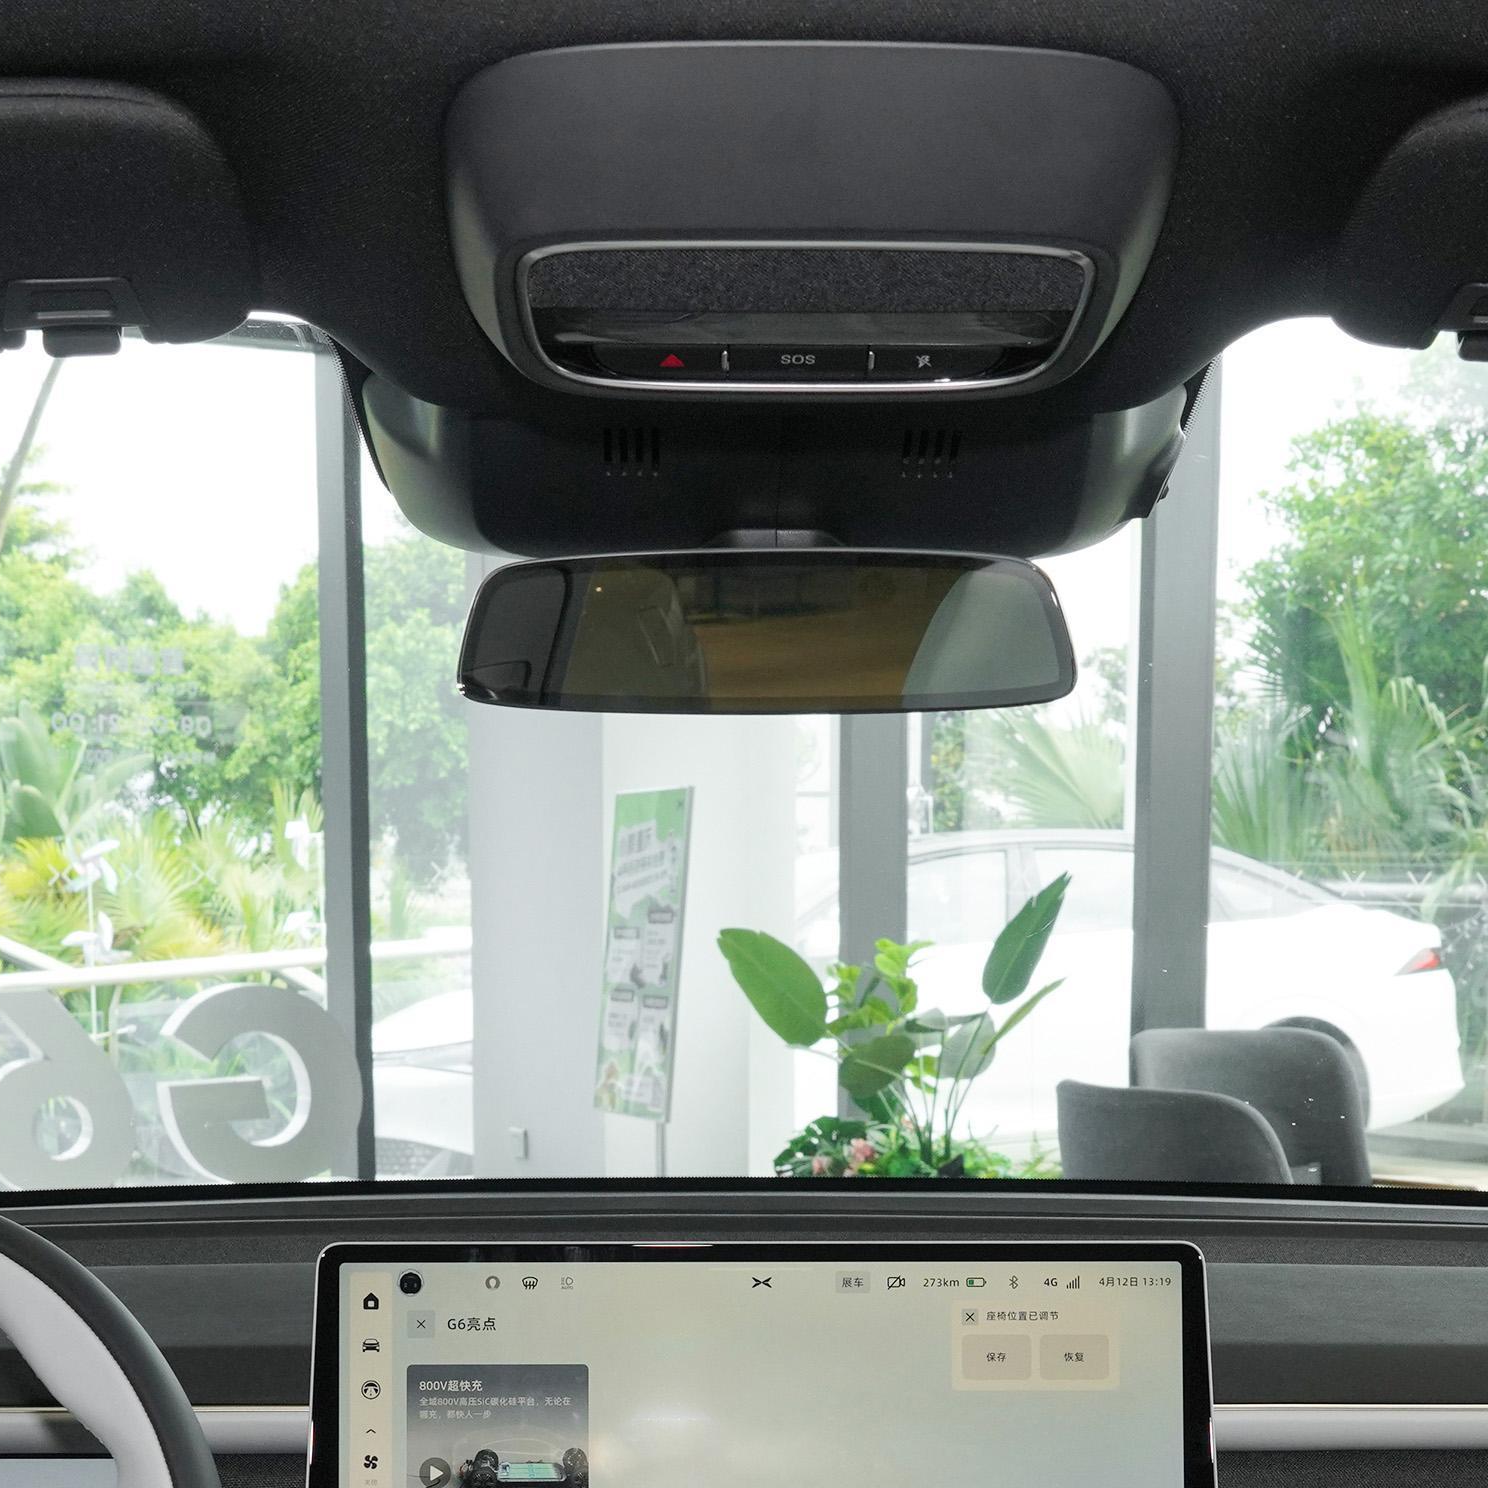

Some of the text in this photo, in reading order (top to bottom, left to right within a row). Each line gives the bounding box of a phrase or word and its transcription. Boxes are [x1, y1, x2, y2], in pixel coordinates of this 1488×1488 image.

[781, 353, 816, 365] SOS
[841, 1276, 864, 1289] 展车
[922, 1277, 960, 1288] 273km
[1043, 1277, 1059, 1288] 4G
[1098, 1276, 1172, 1288] 4月12日 13:19
[985, 1310, 1060, 1322] 座椅位置已调节
[447, 1317, 497, 1332] G6亮点
[985, 1351, 1007, 1363] 保存
[1063, 1351, 1085, 1363] 恢复
[418, 1379, 484, 1392] 800V超快充
